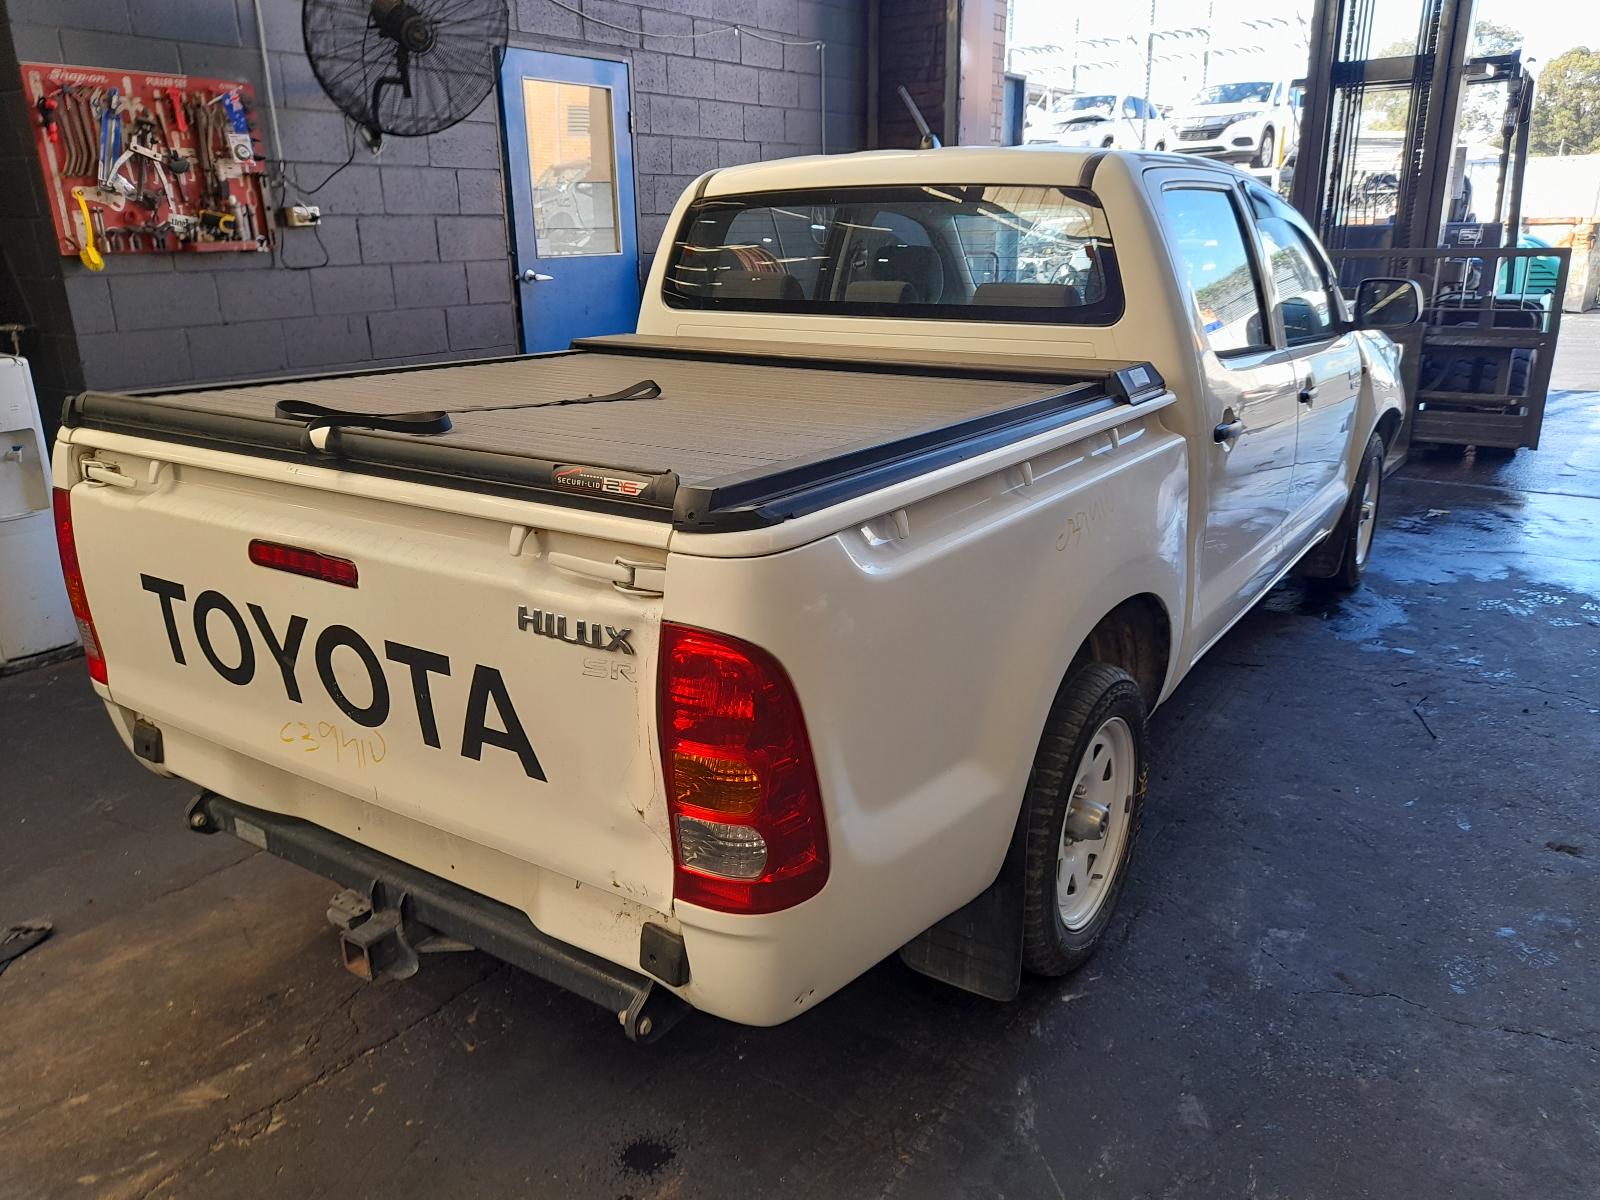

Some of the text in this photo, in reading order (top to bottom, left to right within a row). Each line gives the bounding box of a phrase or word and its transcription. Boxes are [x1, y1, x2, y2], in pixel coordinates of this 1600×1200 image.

[48, 68, 109, 84] Snap-on
[557, 476, 600, 489] SECURI-LID
[518, 604, 635, 656] HILUX
[140, 573, 548, 783] TOYOTA
[582, 658, 637, 683] SR
